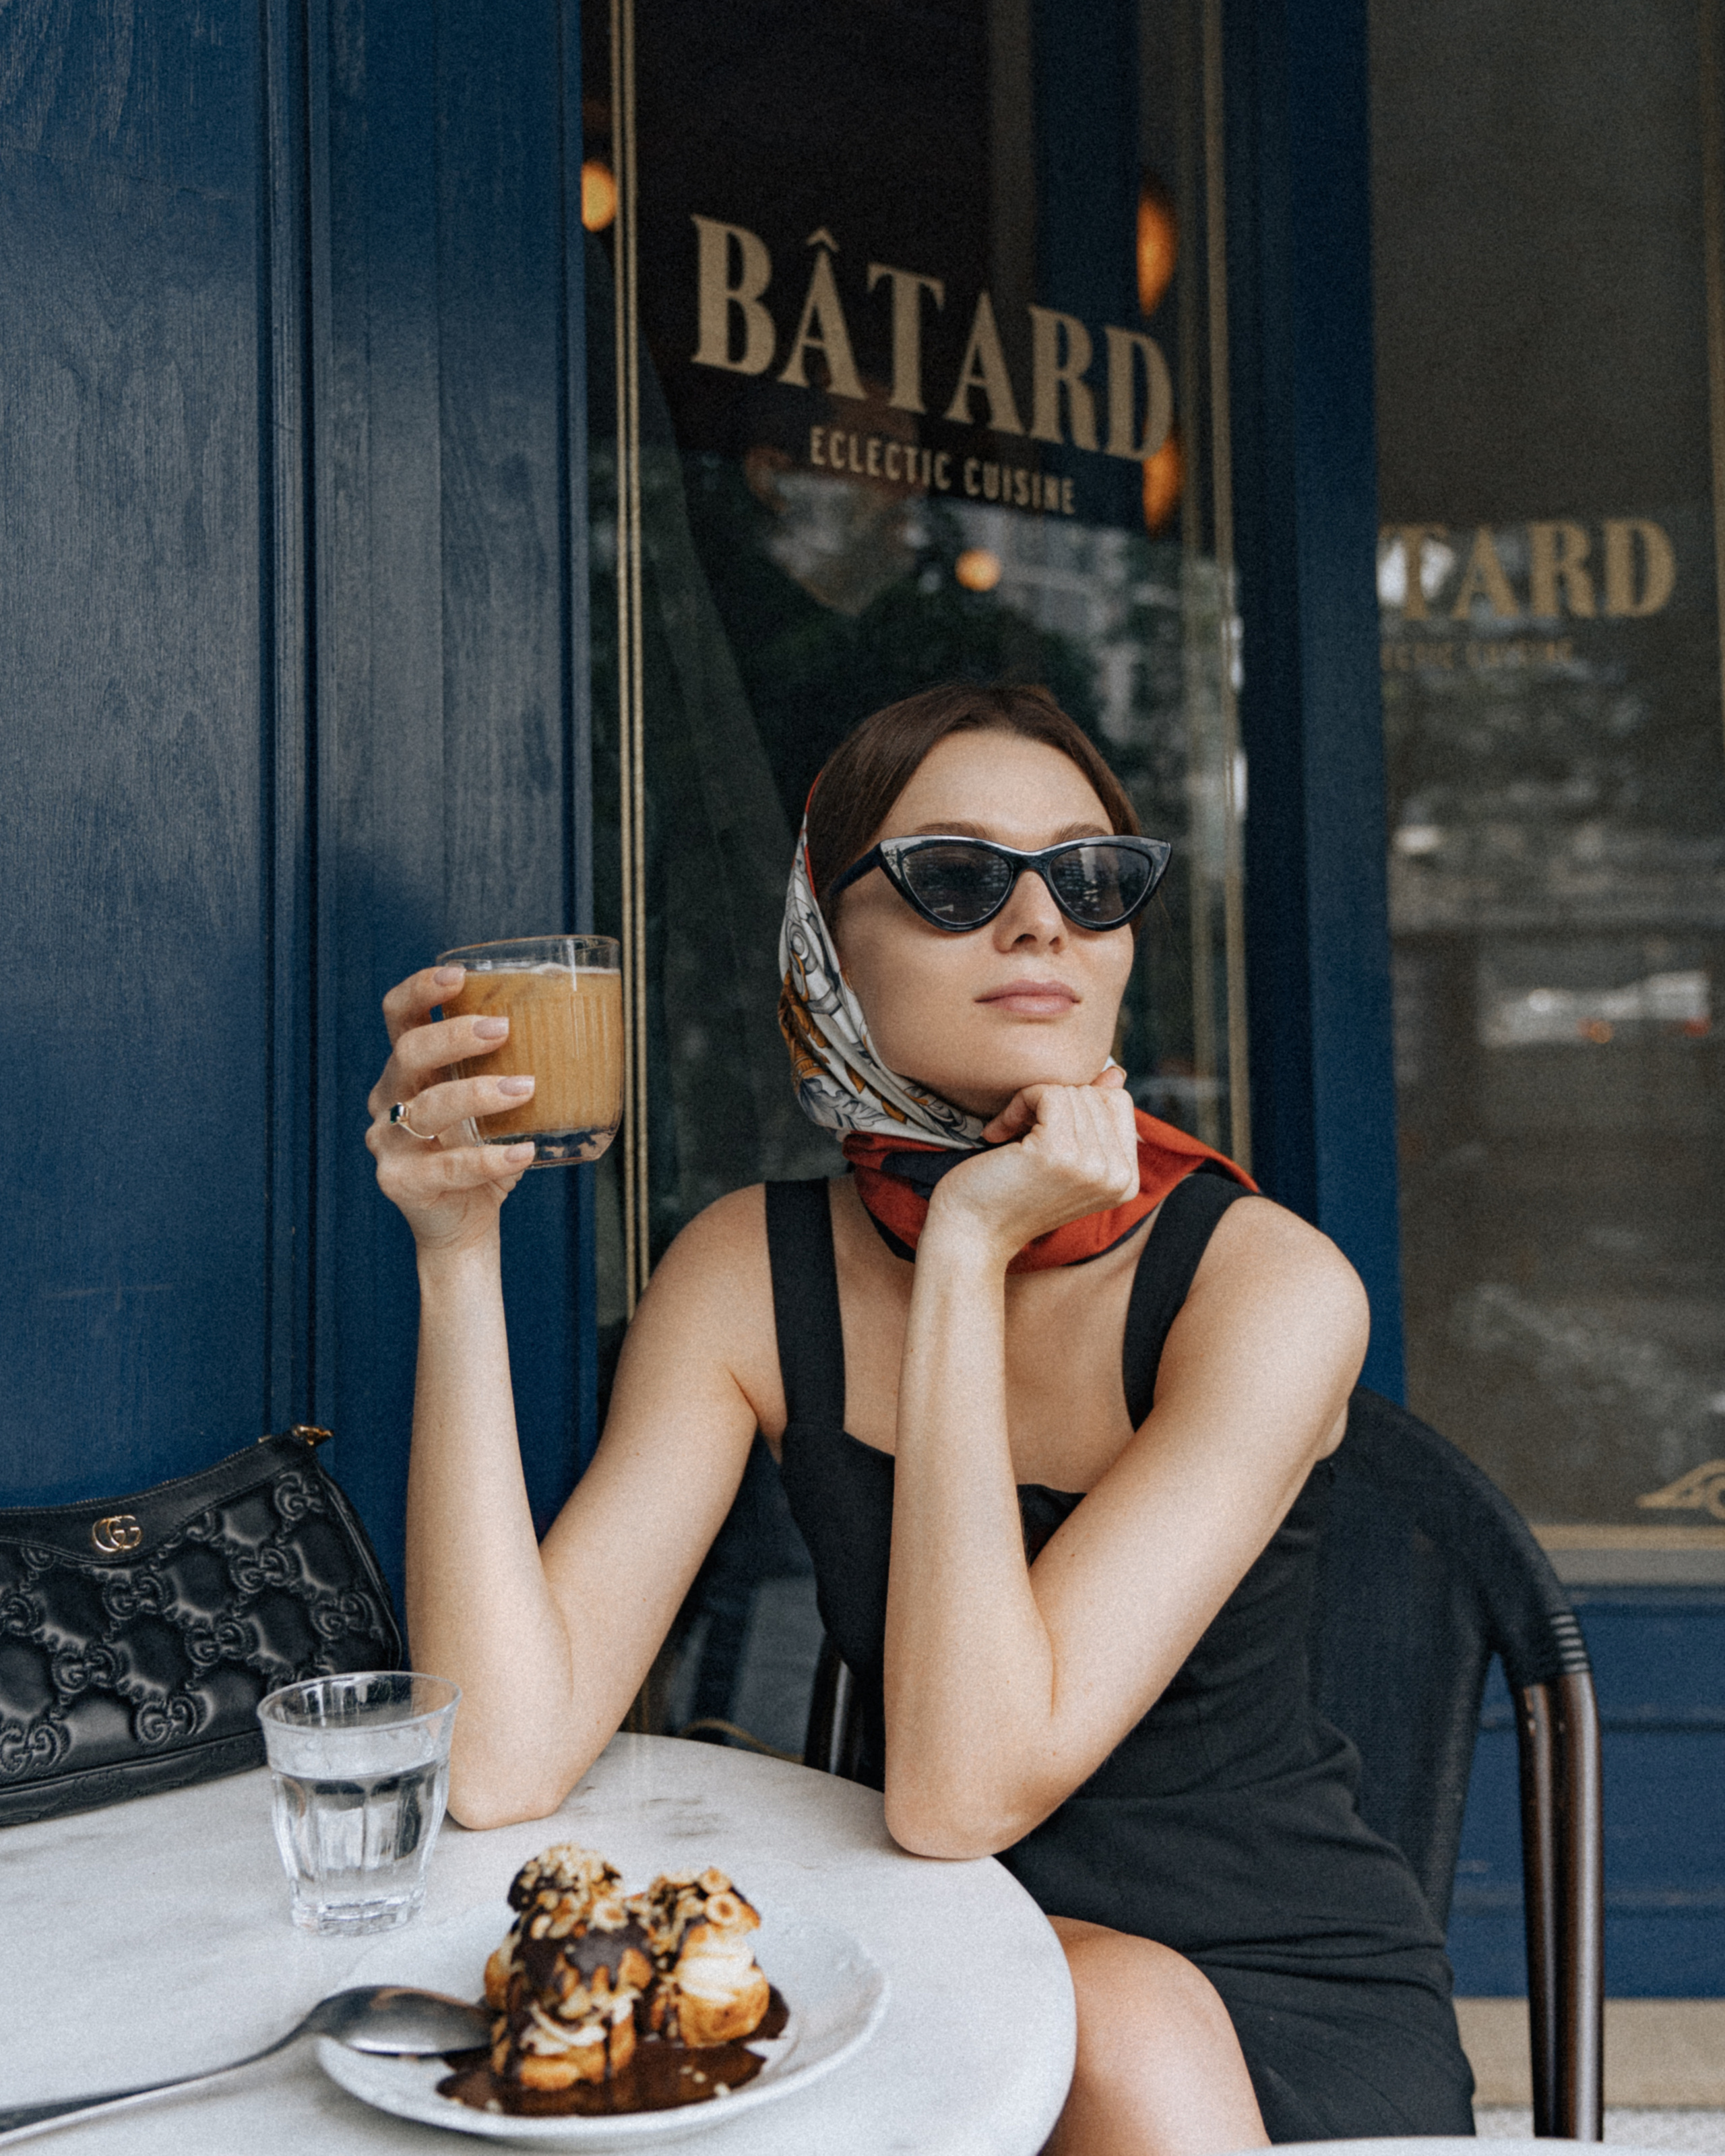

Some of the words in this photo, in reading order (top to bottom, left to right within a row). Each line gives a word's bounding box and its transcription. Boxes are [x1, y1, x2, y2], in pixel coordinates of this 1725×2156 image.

[690, 213, 1173, 462] BÂTARD
[810, 425, 951, 491] ECLECTIC
[963, 457, 1076, 514] CUISINE
